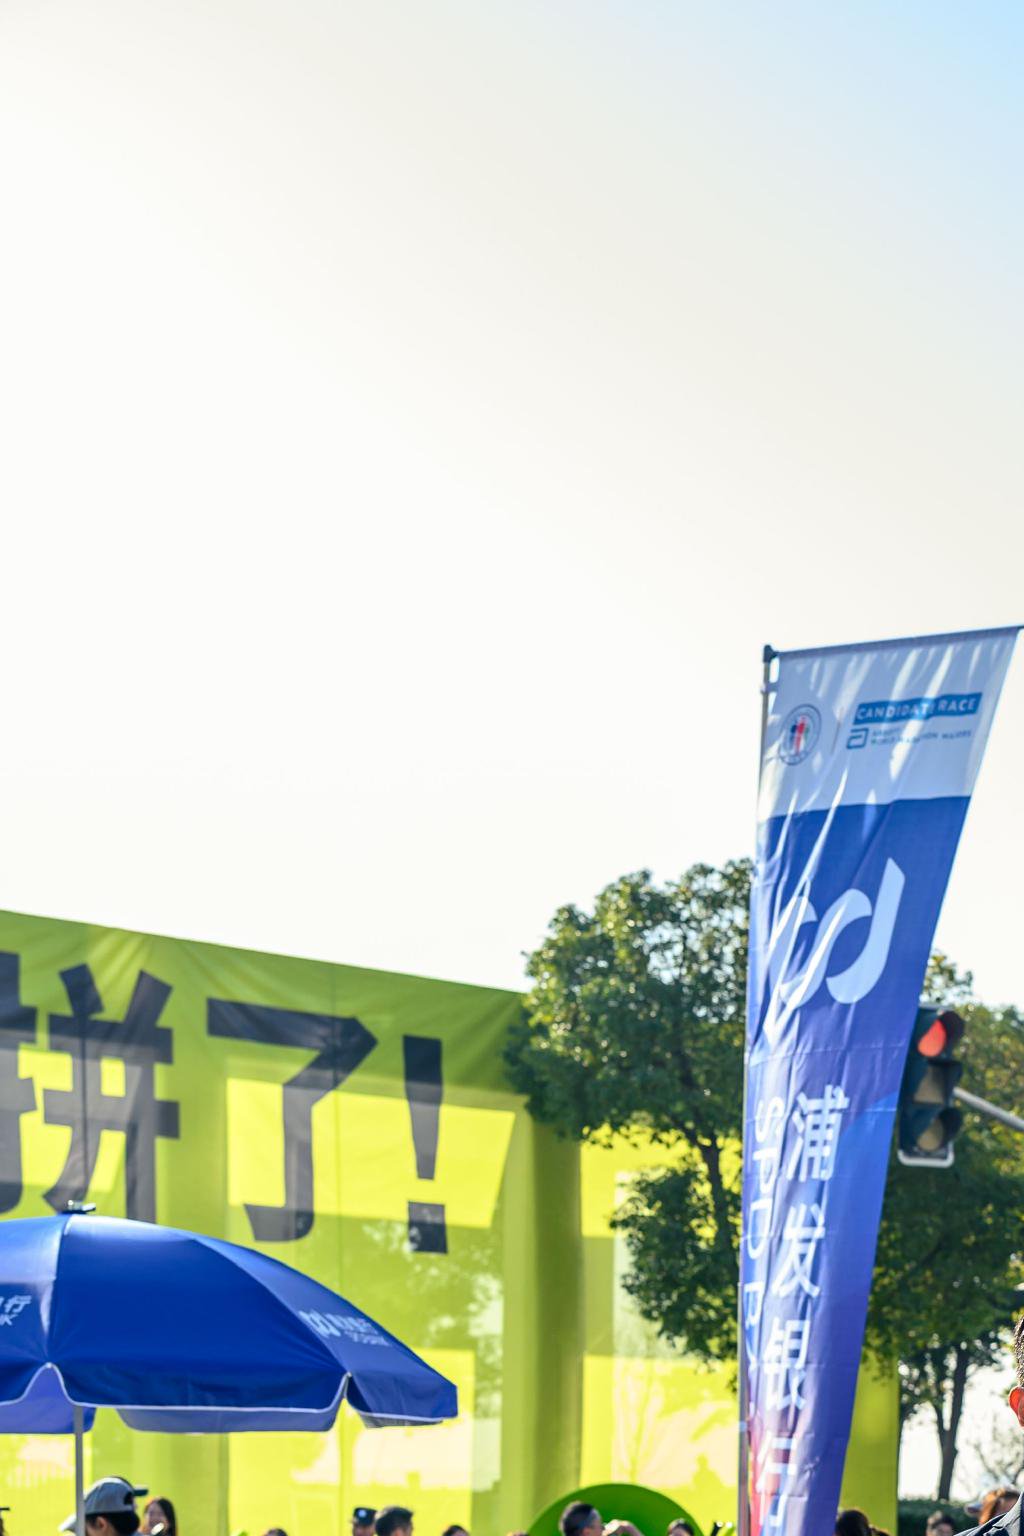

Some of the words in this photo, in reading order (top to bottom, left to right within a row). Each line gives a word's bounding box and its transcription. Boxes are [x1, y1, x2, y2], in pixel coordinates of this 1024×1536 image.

[938, 698, 977, 713] RACE
[745, 1096, 785, 1260] SPD
[756, 1084, 850, 1528] 浦发银行
